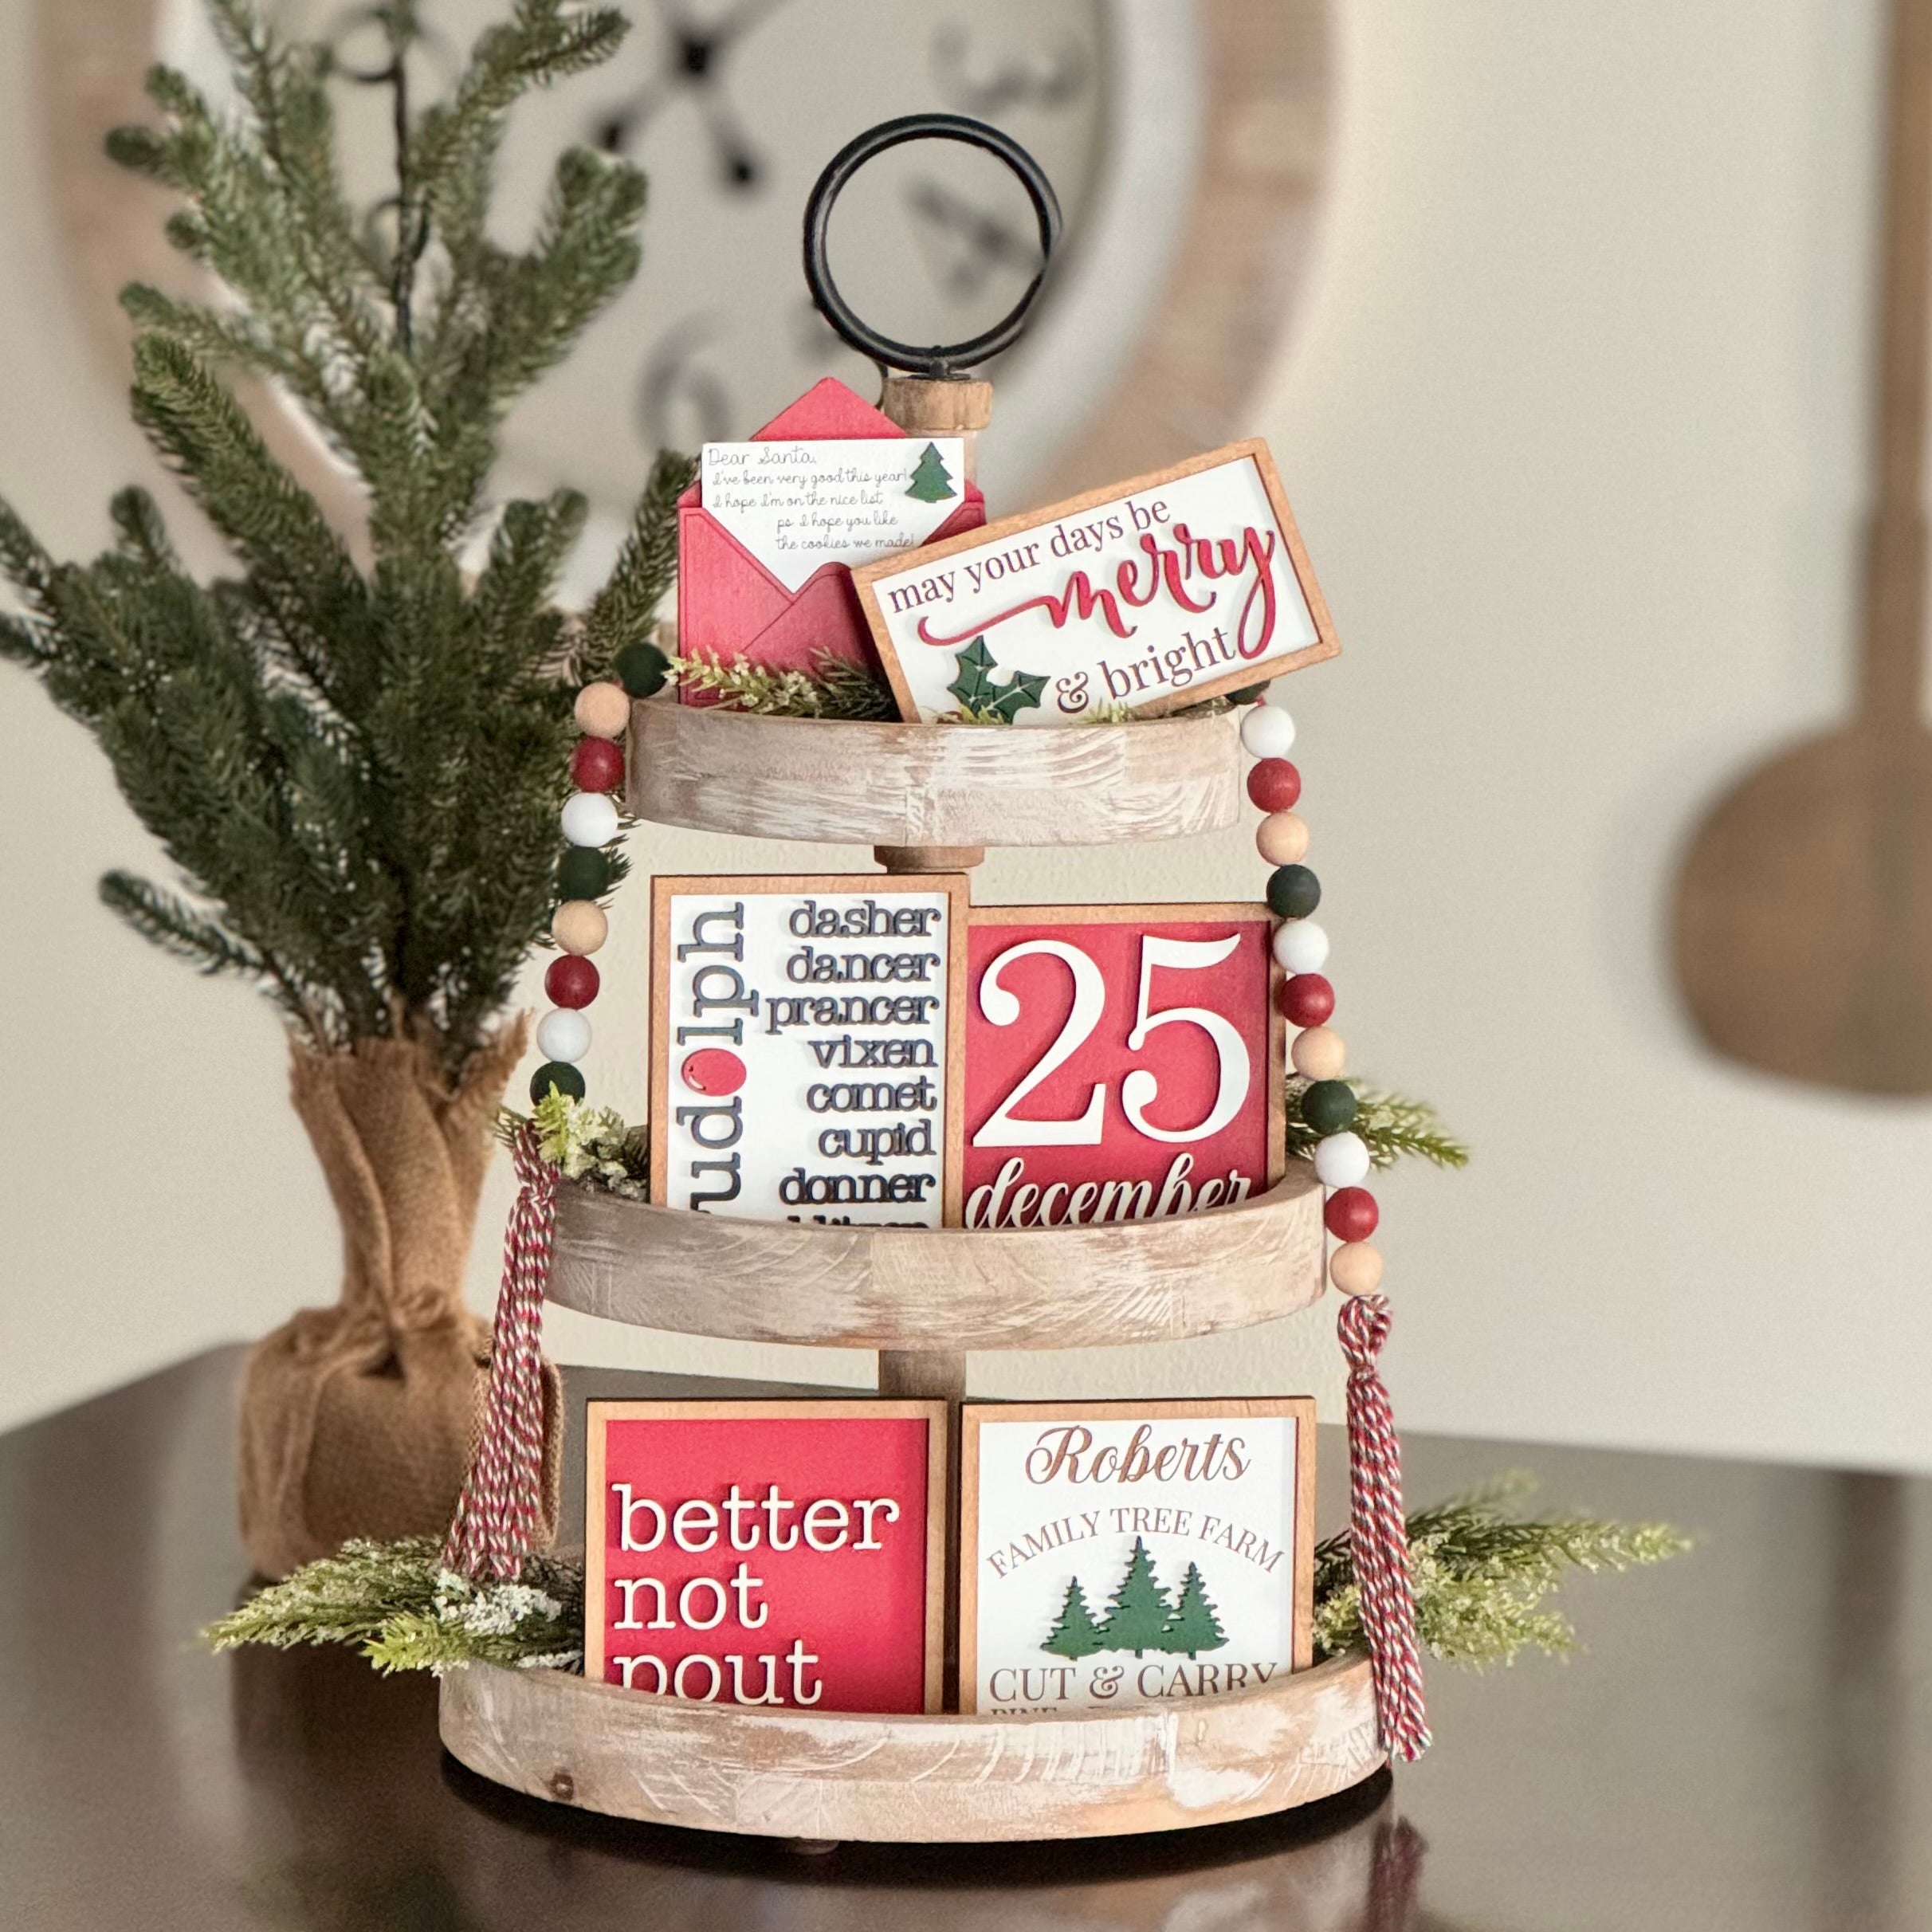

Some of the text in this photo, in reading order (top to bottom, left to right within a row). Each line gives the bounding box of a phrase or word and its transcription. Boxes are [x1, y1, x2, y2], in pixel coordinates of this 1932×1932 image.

[708, 448, 750, 465] Dear
[713, 467, 907, 489] I've been very good this year!
[713, 489, 883, 514] I hope I'm on the nice list
[775, 532, 914, 550] the cookies we made!
[777, 510, 898, 534] ps I hope you like
[887, 500, 1172, 614] may your days be
[917, 523, 1275, 660] merry
[1055, 626, 1237, 713] & bright
[788, 899, 941, 938] dasher
[786, 945, 940, 984] dancer
[764, 995, 940, 1035] prancer
[807, 1035, 938, 1069] vixen
[972, 933, 1251, 1148] 25
[806, 1075, 937, 1113] comet
[818, 1118, 937, 1166] cupid
[779, 1167, 936, 1205] donner
[965, 1153, 1251, 1231] december
[1025, 1423, 1252, 1485] Roberts
[611, 1483, 900, 1553] better
[986, 1506, 1286, 1580] FAMILY TREE FARM
[614, 1562, 768, 1630] not
[989, 1667, 1076, 1702] CUT
[1089, 1665, 1125, 1700] &
